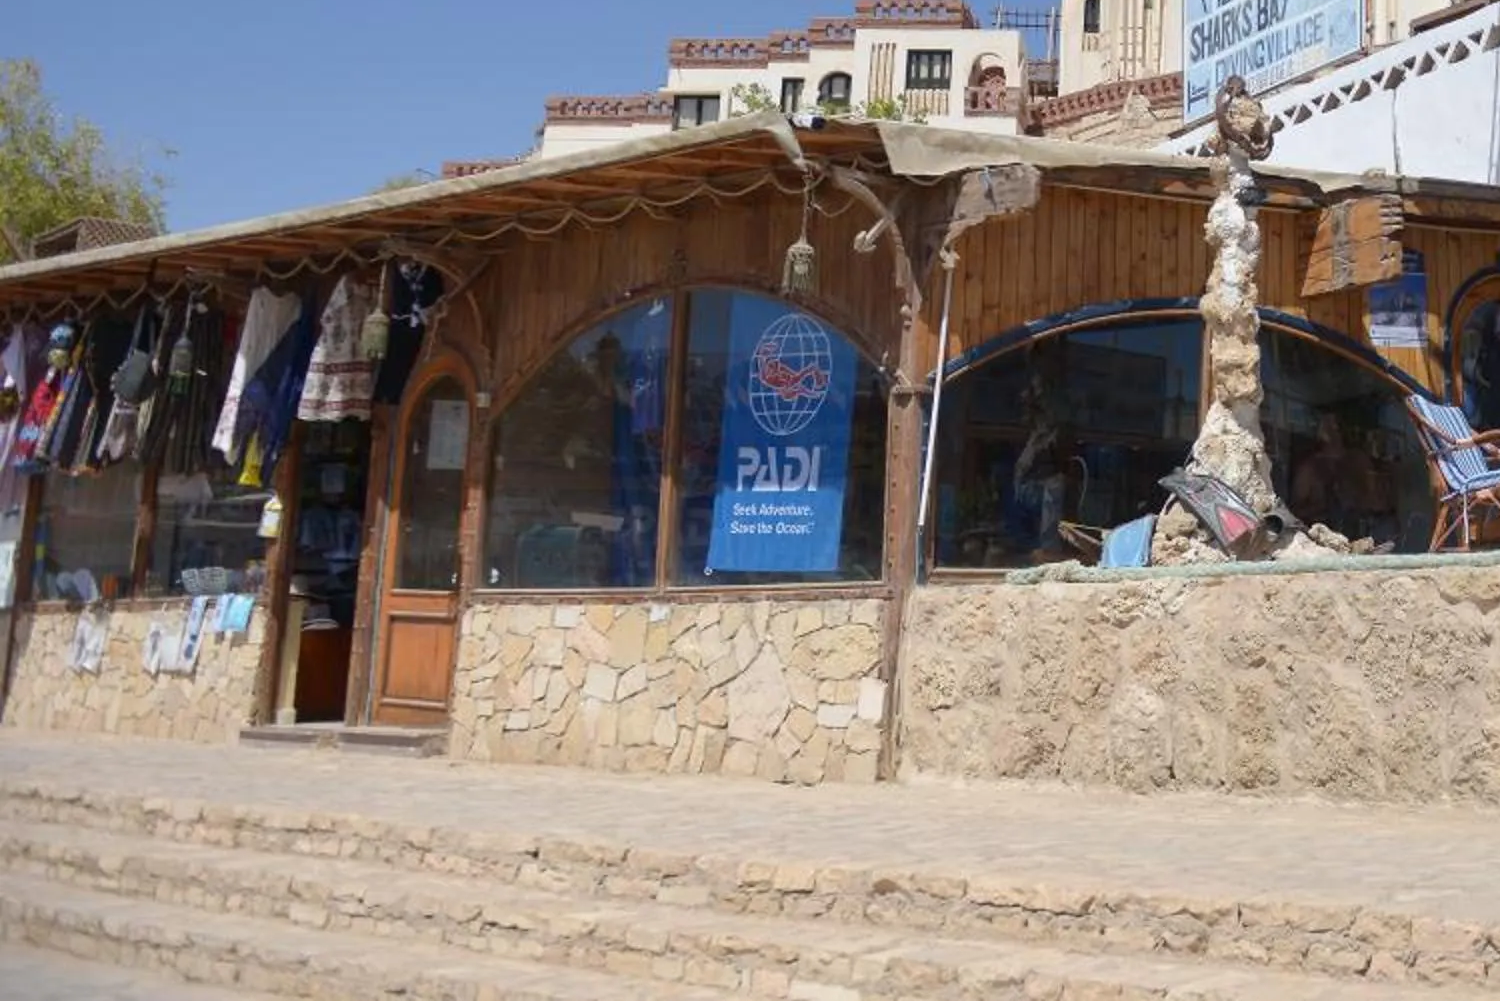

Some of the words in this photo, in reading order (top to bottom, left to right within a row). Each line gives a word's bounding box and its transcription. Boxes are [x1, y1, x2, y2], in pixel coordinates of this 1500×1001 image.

[1190, 0, 1252, 62] SHARKS
[1265, 11, 1325, 58] VILLAGE
[736, 446, 821, 492] PADI
[730, 520, 756, 534] Save
[757, 522, 773, 534] the
[733, 503, 757, 516] Seek
